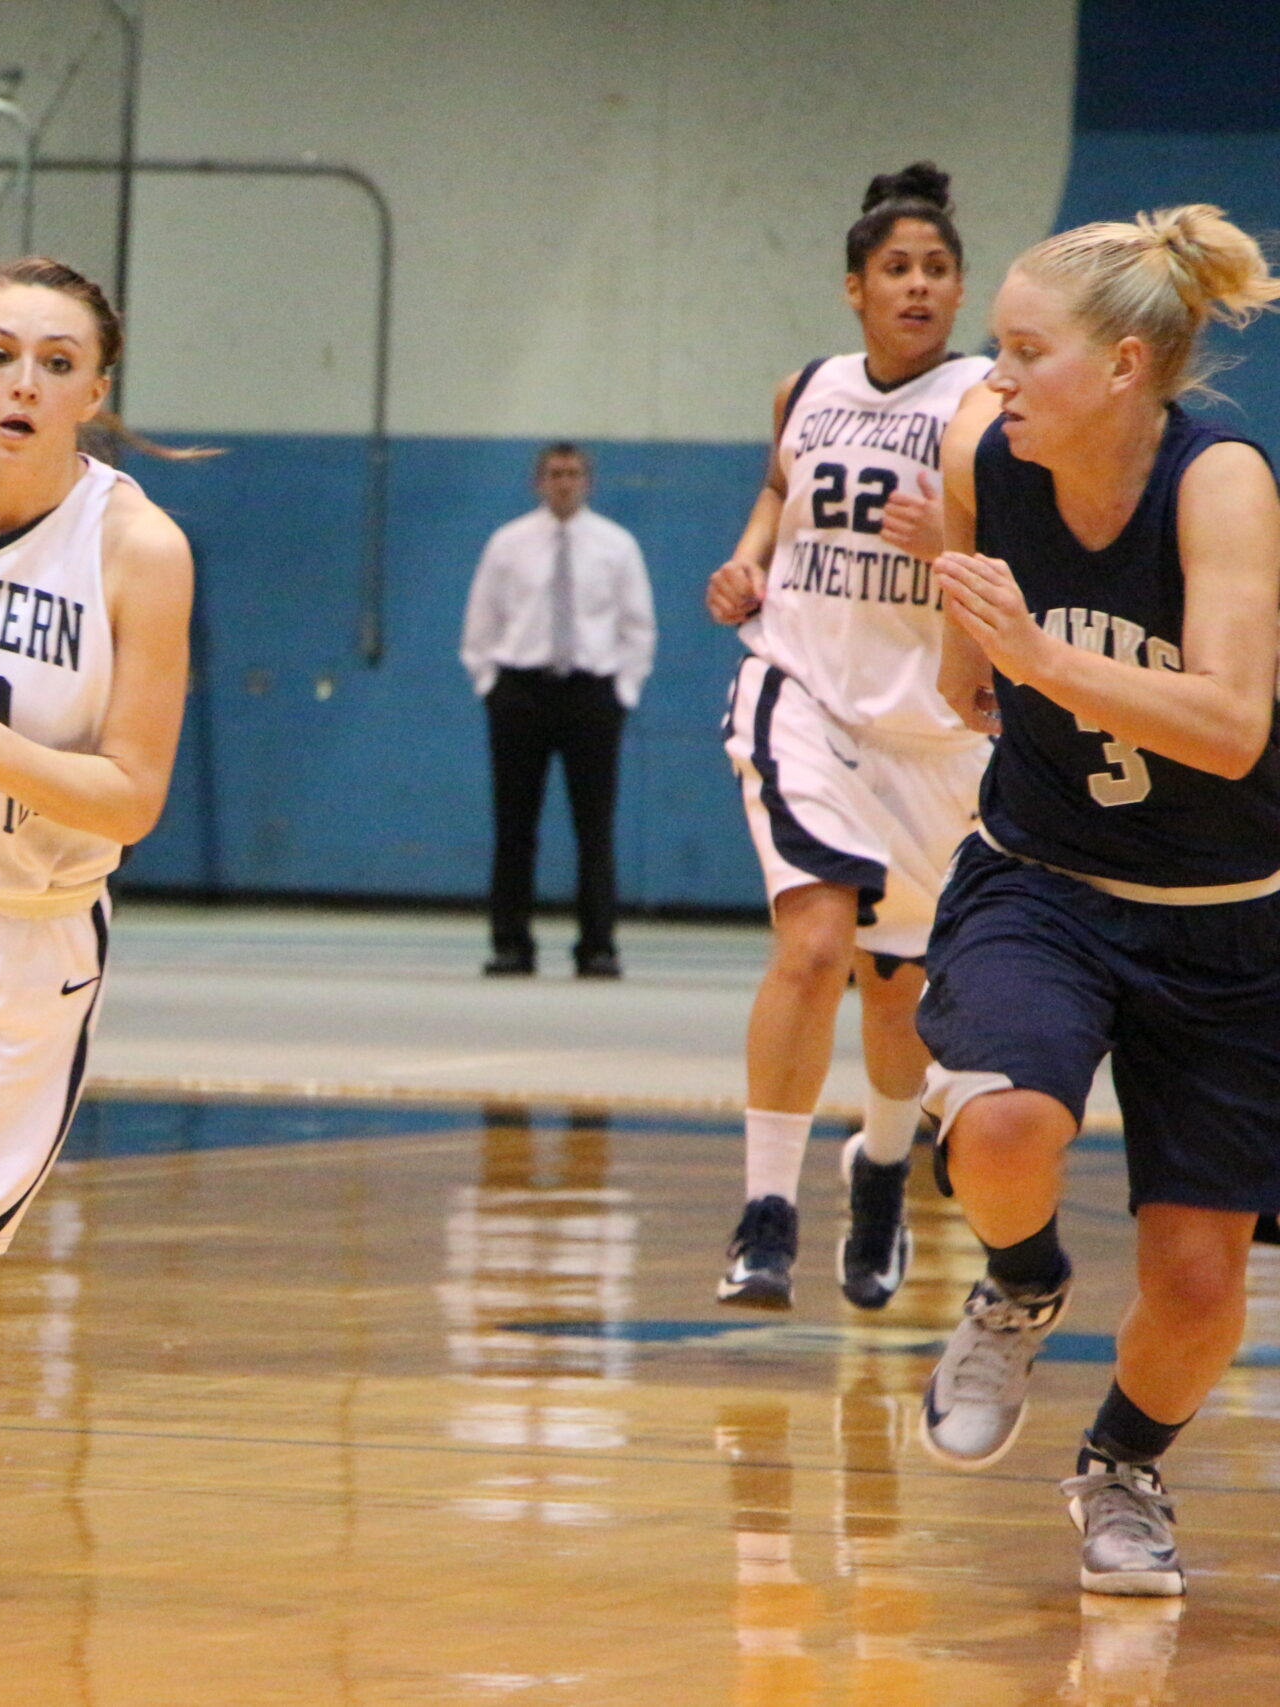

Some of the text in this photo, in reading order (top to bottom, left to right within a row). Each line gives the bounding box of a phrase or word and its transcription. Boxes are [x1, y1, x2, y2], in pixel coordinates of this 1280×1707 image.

[795, 408, 948, 470] SOUTHERN
[812, 462, 899, 534] 22
[1031, 607, 1184, 672] AWKS
